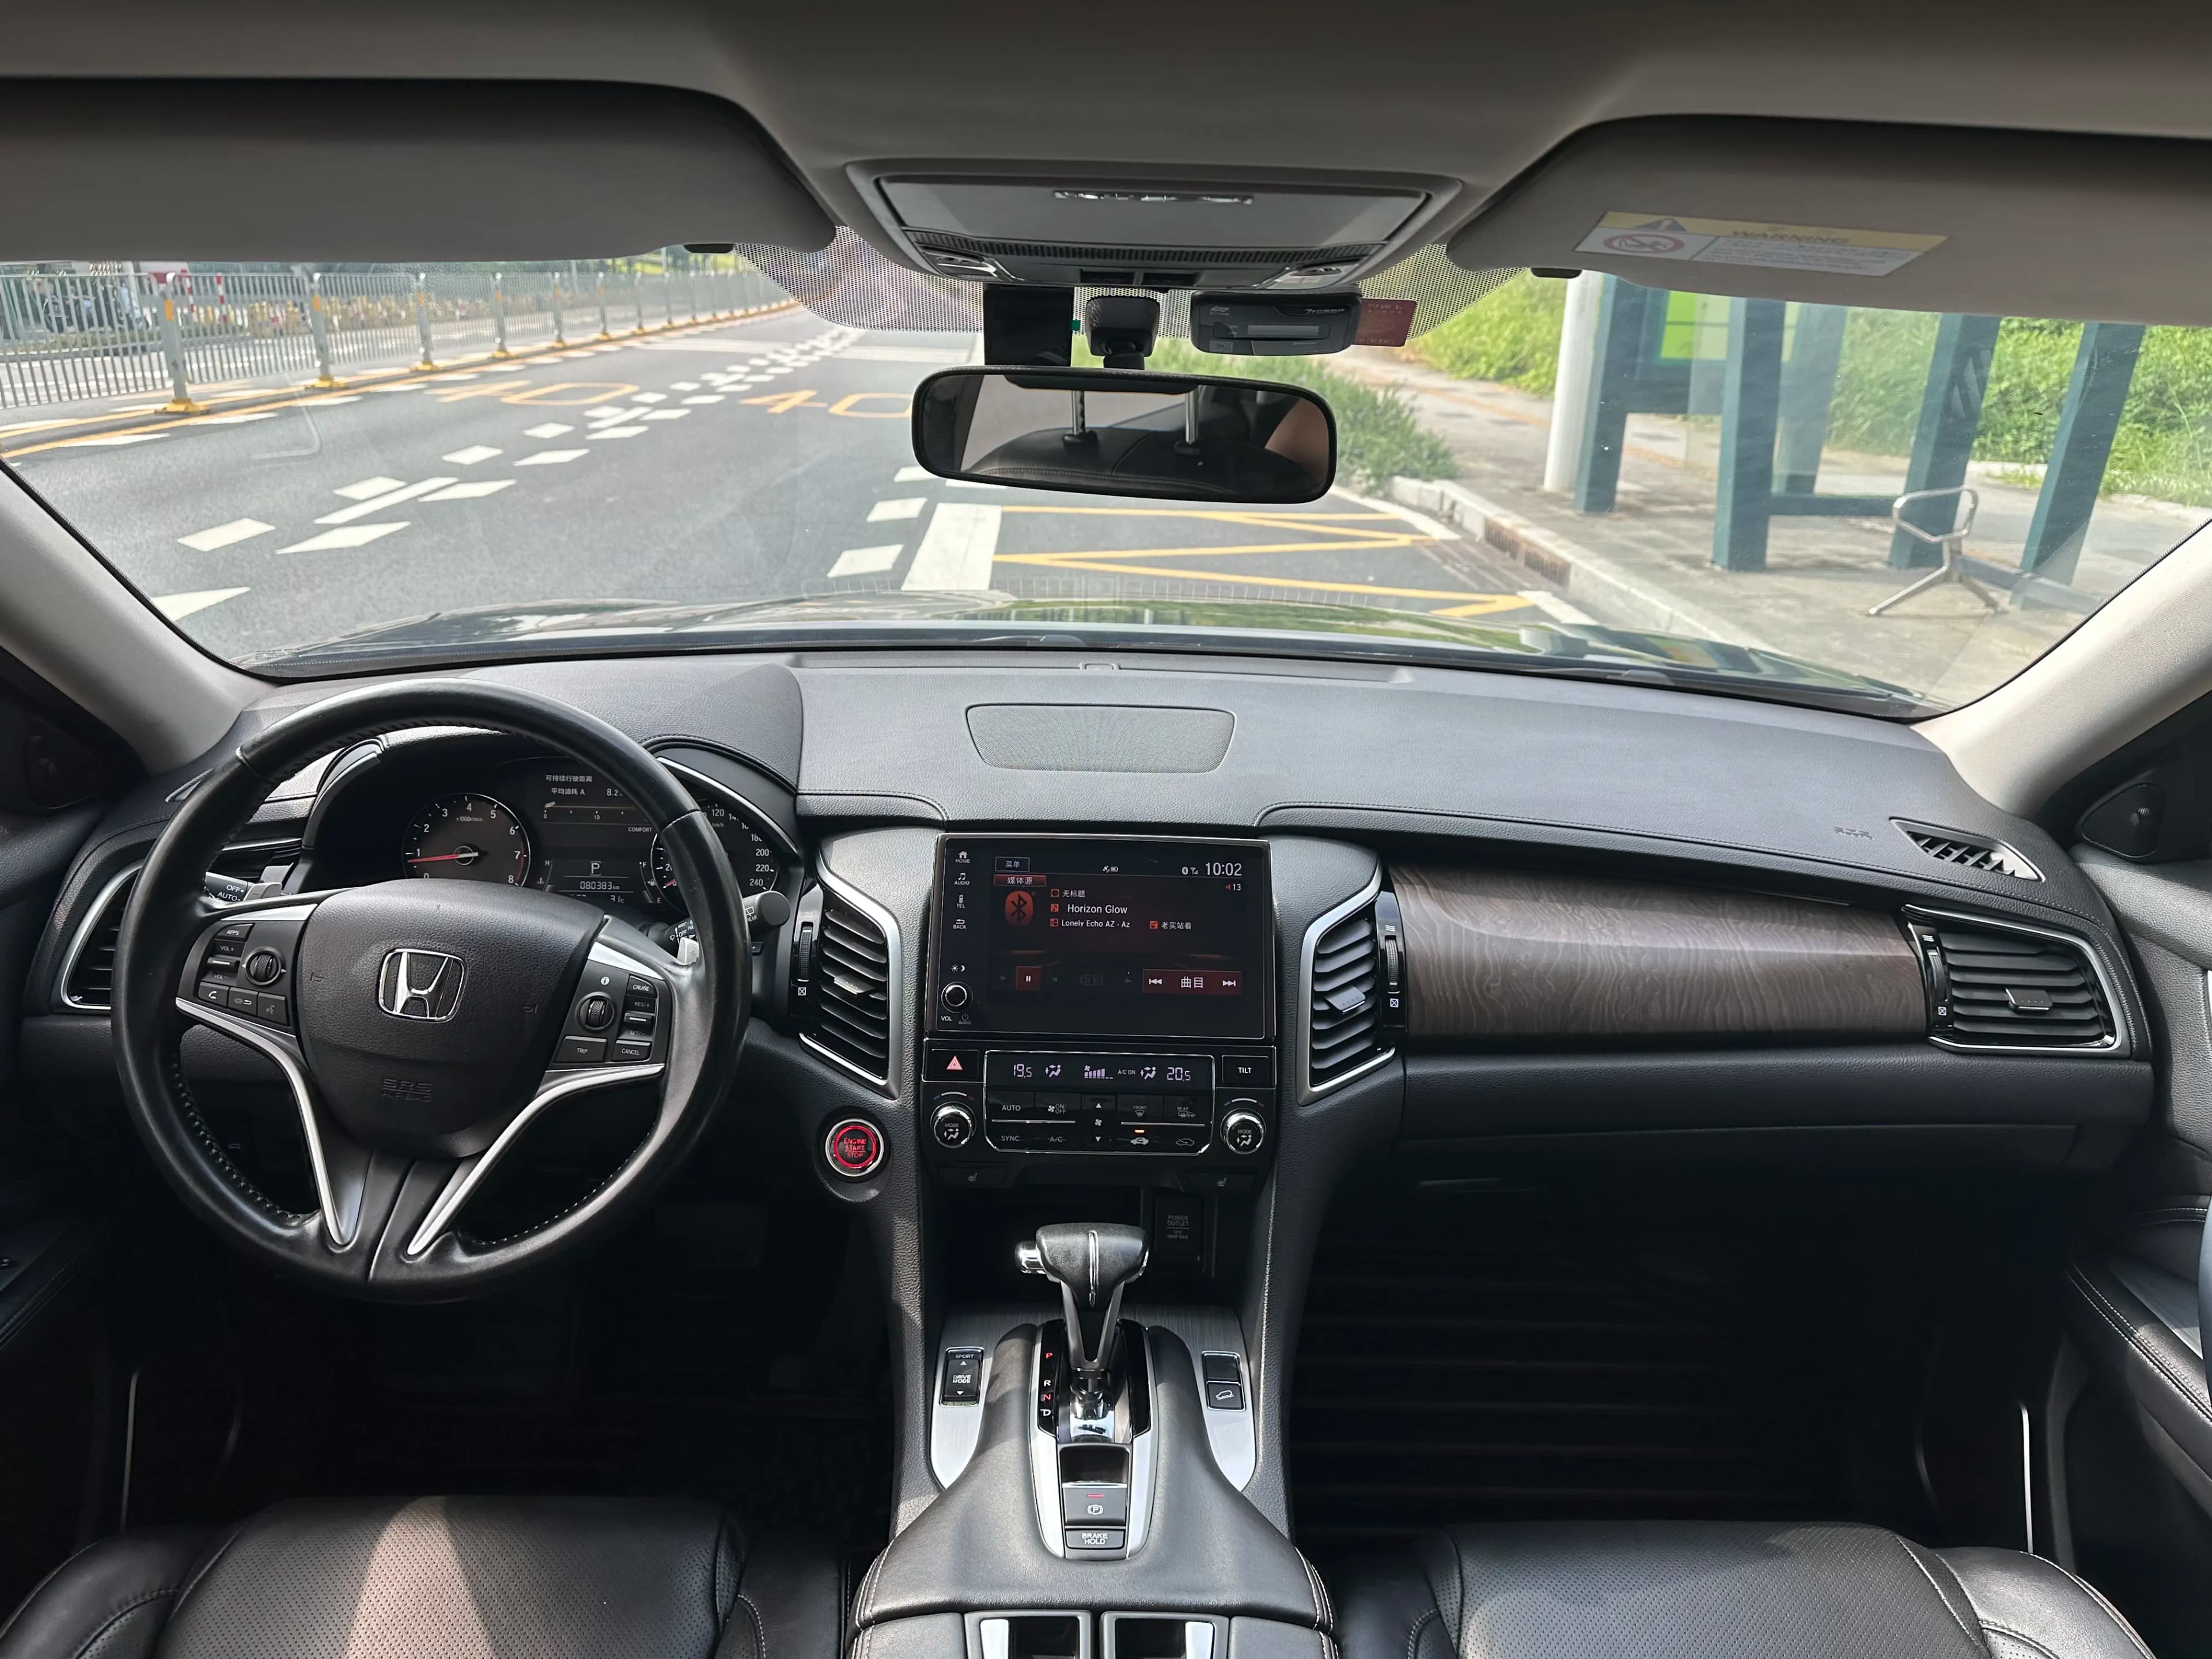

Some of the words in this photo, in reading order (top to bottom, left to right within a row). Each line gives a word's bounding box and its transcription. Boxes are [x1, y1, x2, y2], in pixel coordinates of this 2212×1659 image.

[467, 803, 472, 811] 4
[442, 808, 448, 817] 3
[490, 810, 496, 819] 5
[423, 824, 429, 832] 2
[509, 827, 515, 835] 6
[416, 849, 420, 857] 1
[514, 851, 520, 859] 7
[755, 849, 769, 857] 200
[591, 862, 600, 874] P
[1205, 862, 1242, 876] 10:02
[508, 875, 514, 883] 8
[1007, 877, 1033, 885] 媒体源
[226, 884, 241, 893] OFF
[580, 881, 612, 889] 080383
[217, 891, 237, 901] AUTO
[1062, 889, 1085, 897] 无标题
[1067, 904, 1103, 913] Horizon
[1105, 904, 1128, 914] Glow
[1061, 919, 1084, 928] Lonely
[679, 930, 687, 938] OFF
[1181, 976, 1203, 988] 曲目
[632, 984, 649, 992] CRUISE
[622, 1048, 640, 1056] CANCEL
[1013, 1063, 1032, 1078] 19.5
[1166, 1067, 1191, 1081] 20.5
